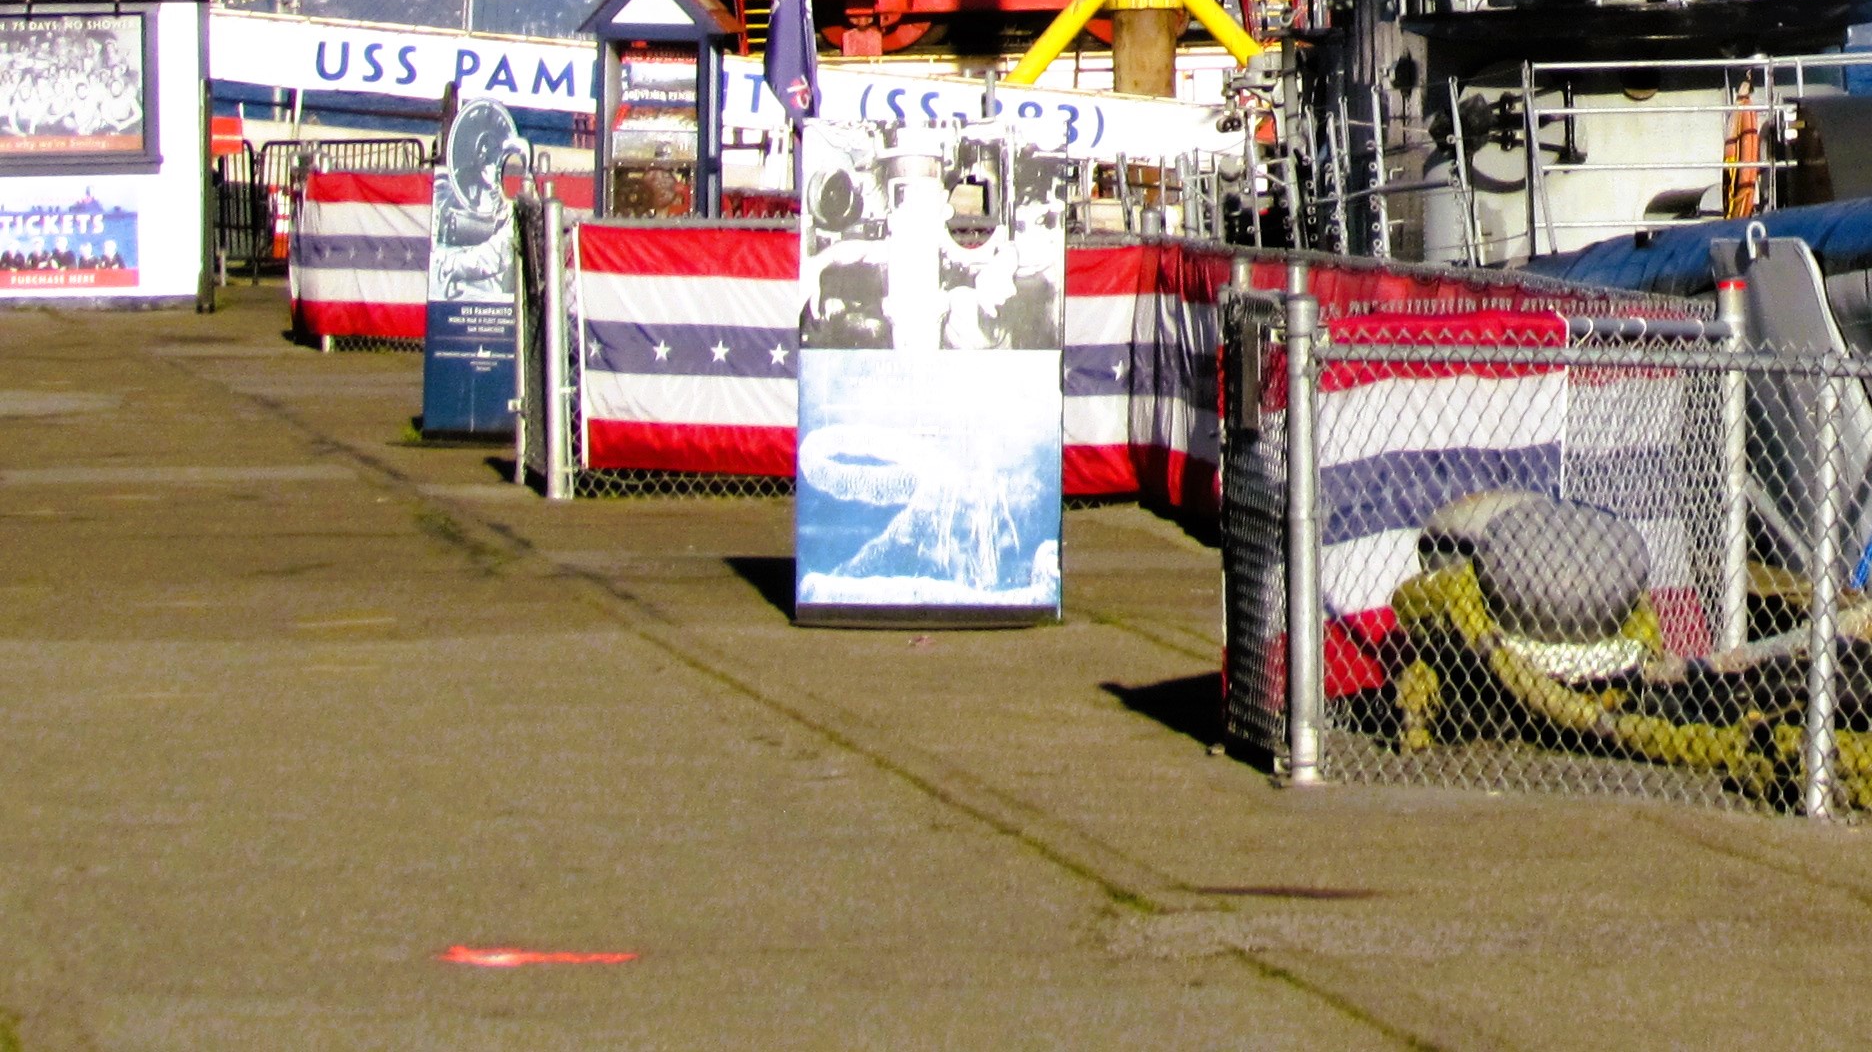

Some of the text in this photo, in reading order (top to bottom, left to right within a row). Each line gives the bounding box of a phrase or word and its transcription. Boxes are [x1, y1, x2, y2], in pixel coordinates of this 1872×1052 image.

[65, 19, 83, 31] NO
[315, 41, 417, 85] USS
[0, 214, 104, 235] TICKETS
[11, 273, 96, 285] PURCHASE HERE
